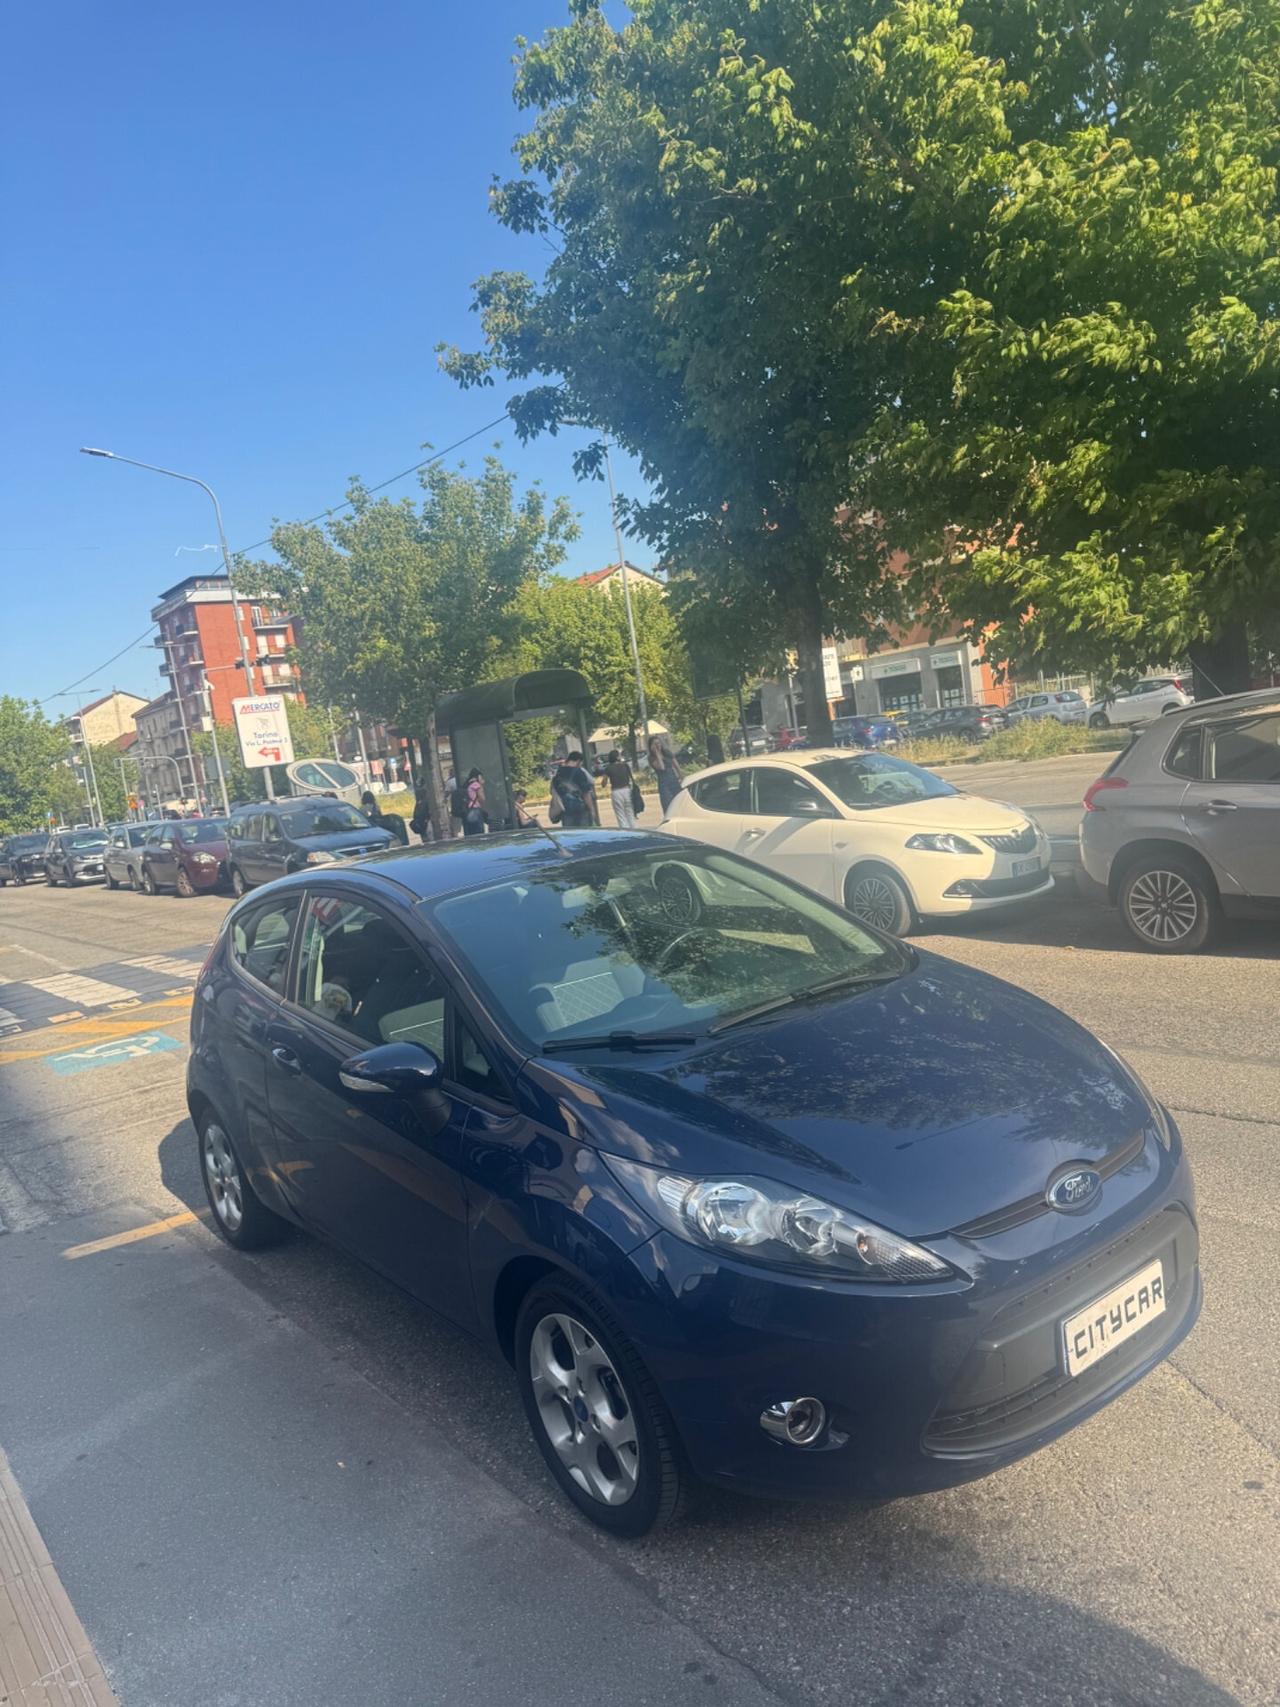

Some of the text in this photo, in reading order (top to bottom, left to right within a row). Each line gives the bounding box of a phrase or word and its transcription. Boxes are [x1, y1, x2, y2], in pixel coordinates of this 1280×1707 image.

[254, 731, 278, 739] Torino
[1064, 1174, 1092, 1201] Ford
[1073, 1276, 1163, 1360] CITYCAR
